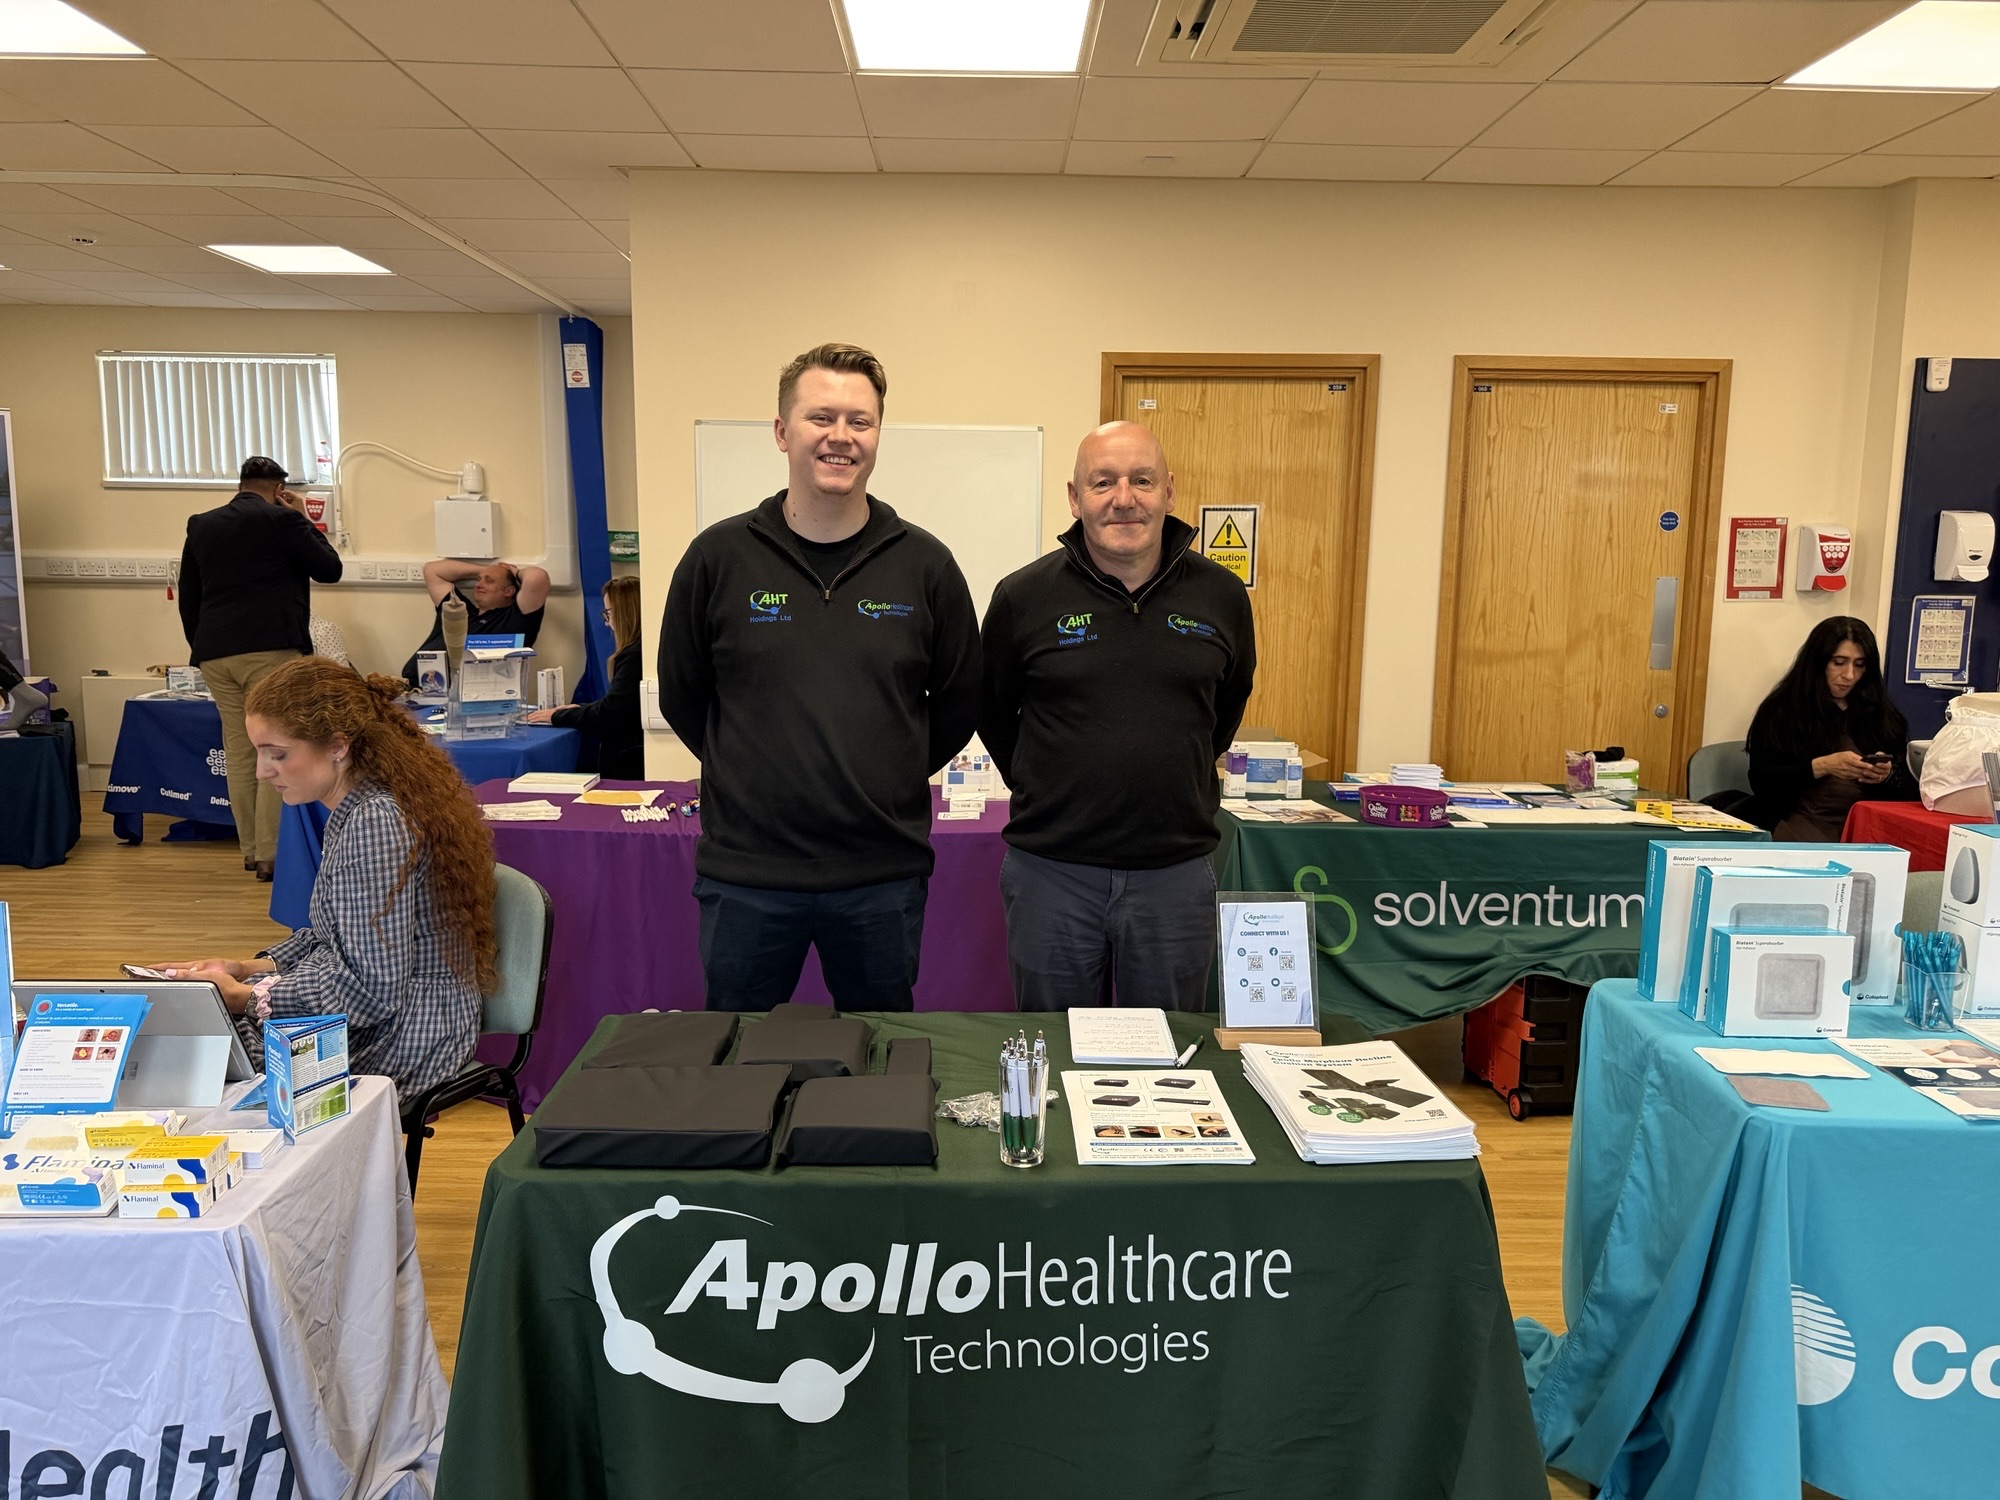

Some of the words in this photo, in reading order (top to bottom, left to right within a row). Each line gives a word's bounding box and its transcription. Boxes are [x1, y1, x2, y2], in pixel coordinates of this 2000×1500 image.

[1210, 553, 1246, 562] Caution
[758, 593, 788, 605] AHT
[750, 616, 777, 624] Holdings
[1066, 613, 1093, 628] AHT
[1058, 636, 1085, 646] Holdings
[160, 787, 190, 800] Cutimed
[1368, 803, 1388, 814] Quality
[1430, 806, 1444, 814] Quality
[1370, 810, 1386, 819] Street
[1373, 880, 1645, 928] solventum
[137, 1162, 165, 1170] Flaminal
[131, 1195, 159, 1203] Flaminal
[903, 1323, 1210, 1376] Technologies
